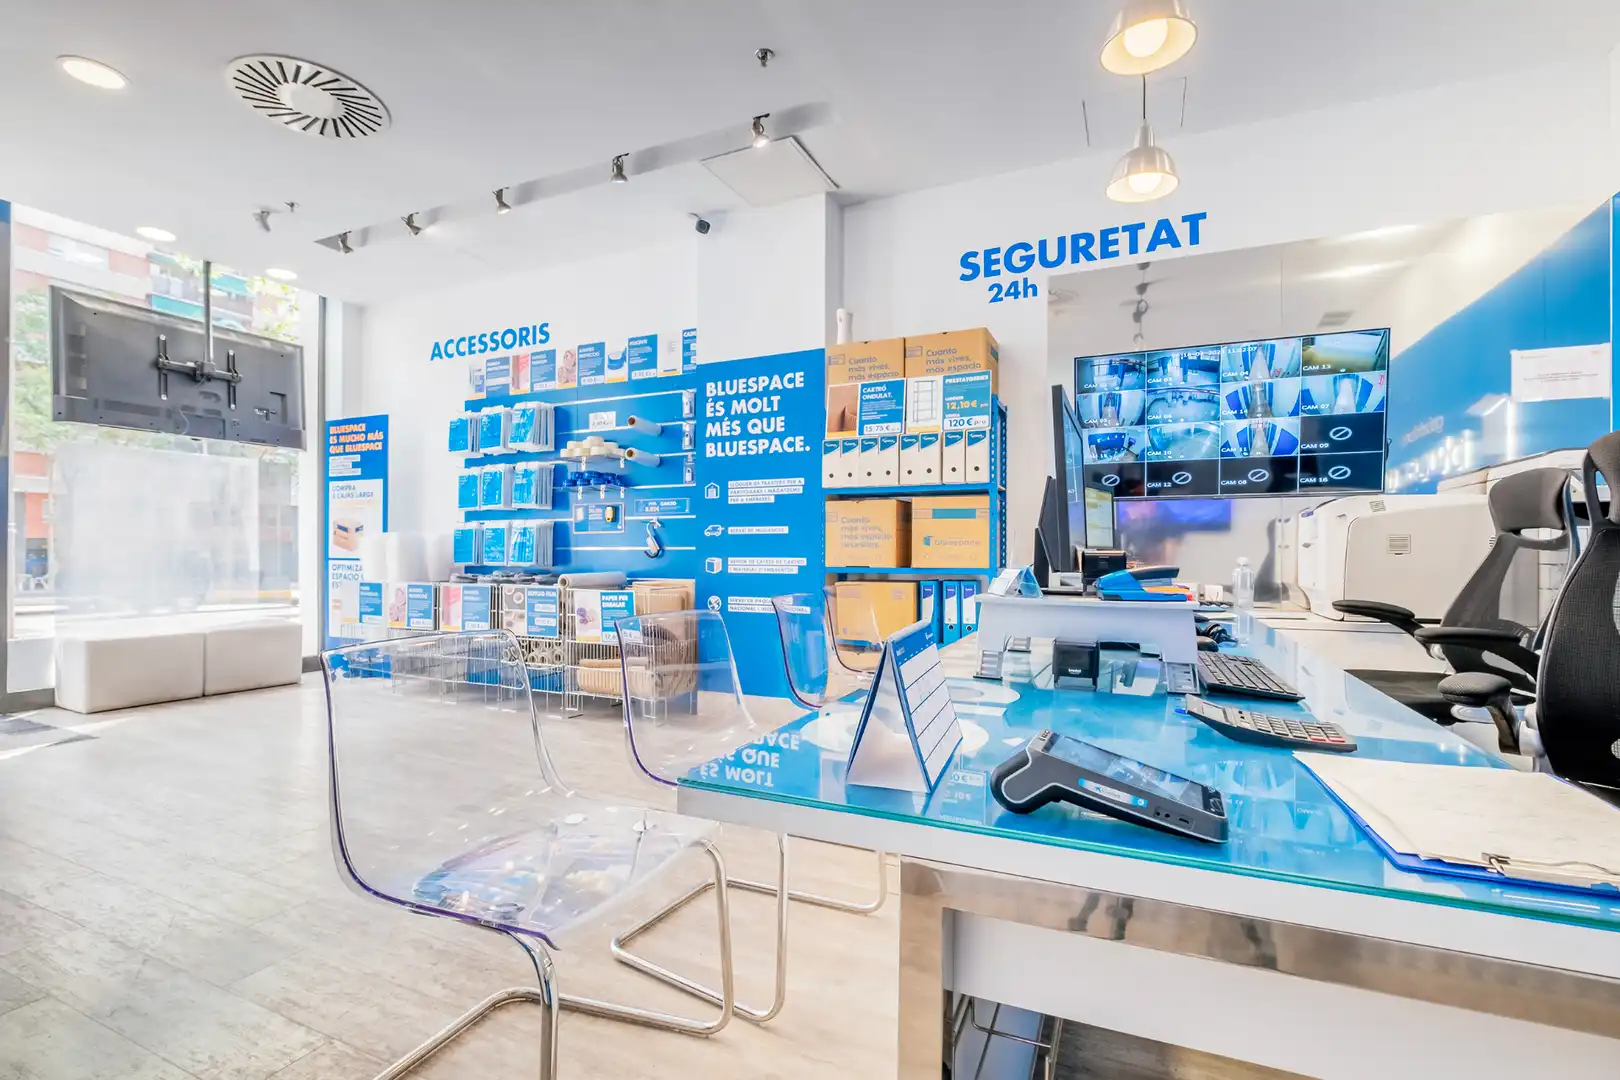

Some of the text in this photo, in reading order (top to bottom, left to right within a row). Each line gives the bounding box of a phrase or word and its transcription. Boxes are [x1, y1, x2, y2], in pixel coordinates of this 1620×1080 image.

[959, 211, 1207, 282] SEGURETAT
[987, 277, 1038, 304] 24h
[430, 322, 550, 361] ACCESSORIS
[926, 348, 957, 357] Cuanto
[848, 356, 877, 365] Cuanto
[926, 357, 945, 365] más
[948, 362, 981, 373] espacio
[867, 371, 899, 380] espacio
[705, 371, 805, 398] BLUESPACE
[705, 395, 781, 418] ÉS MOLT
[946, 400, 970, 410] 12,10
[971, 399, 978, 408] €
[330, 423, 366, 434] BLUESPACE
[705, 416, 786, 438] MÉS QUE
[948, 418, 965, 428] 120
[966, 418, 973, 426] €
[339, 434, 366, 443] MUCHO
[330, 445, 344, 454] QUE
[705, 435, 811, 458] BLUESPACE.
[841, 516, 870, 524] Cuanto
[332, 572, 360, 581] ESPACIO
